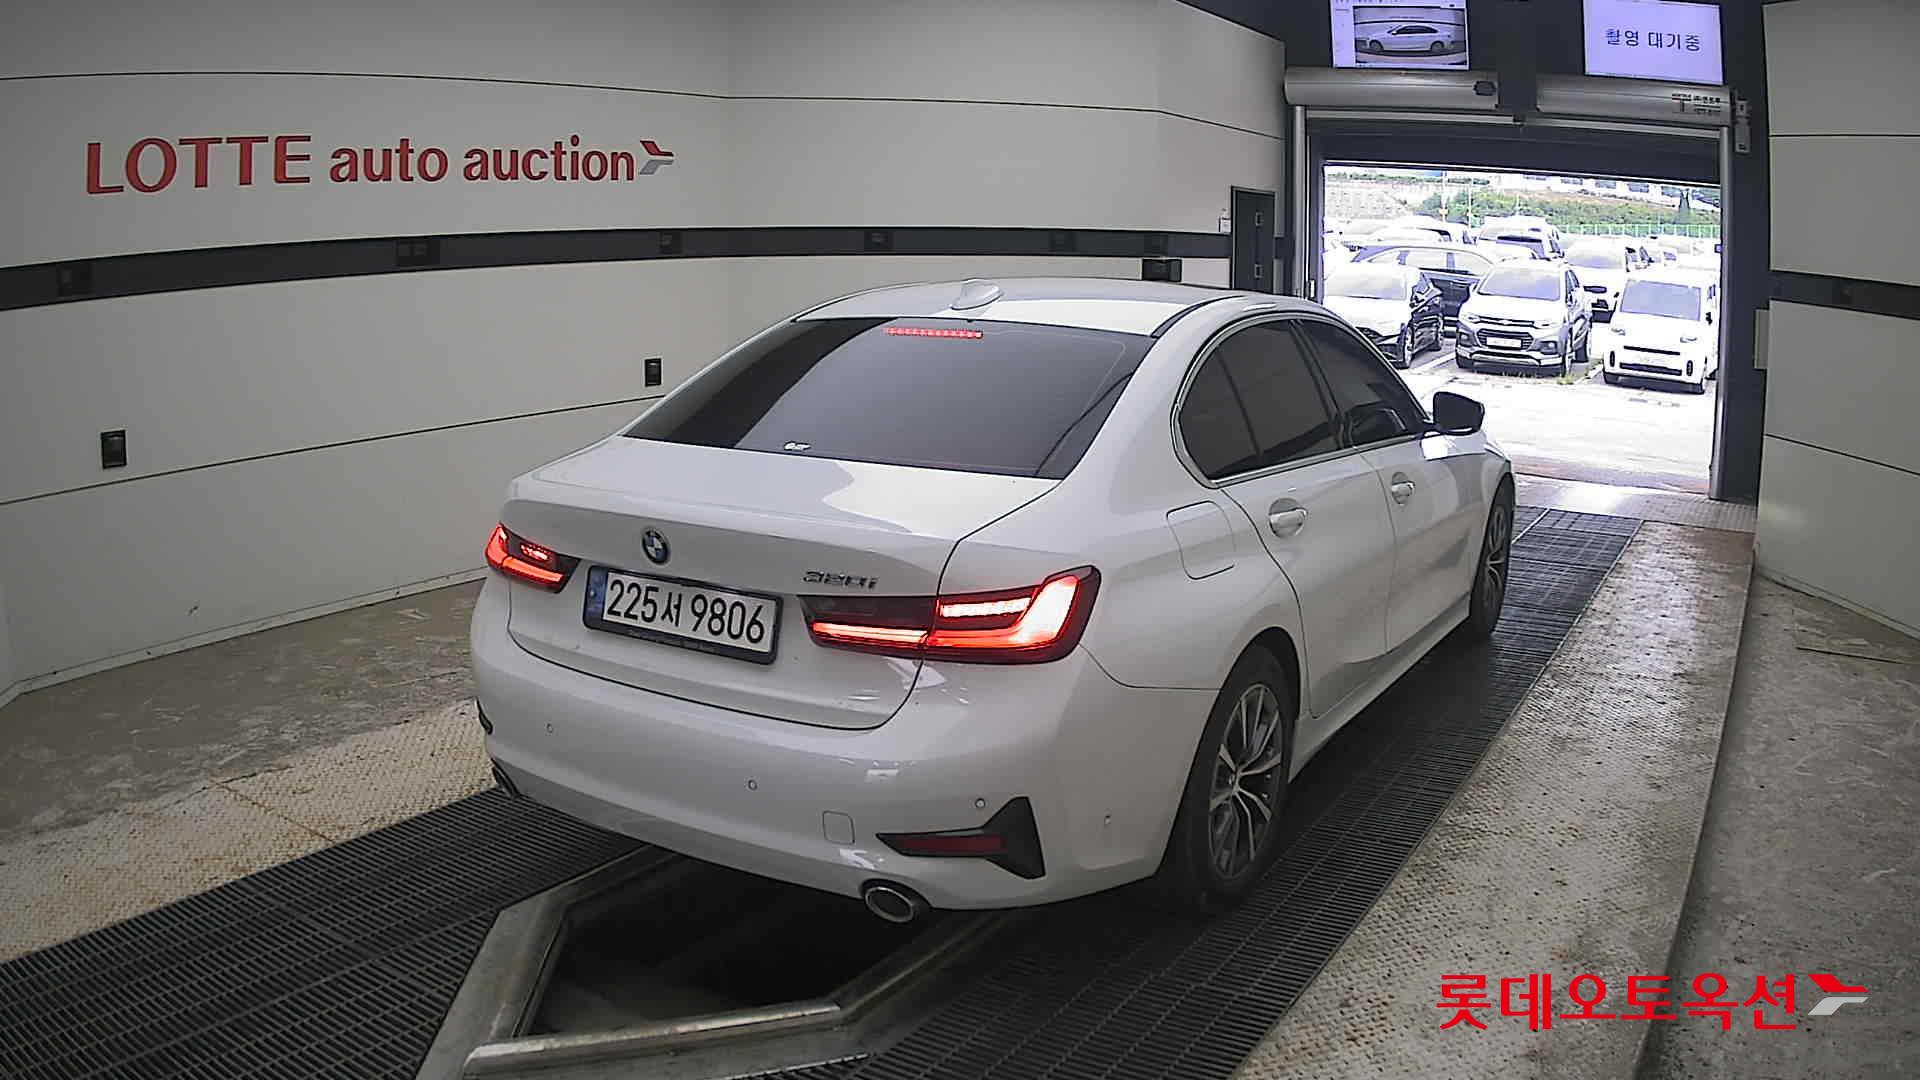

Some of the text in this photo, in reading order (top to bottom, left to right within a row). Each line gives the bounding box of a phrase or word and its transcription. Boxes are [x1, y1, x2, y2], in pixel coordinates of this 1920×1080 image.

[1605, 28, 1701, 52] 촬영 대기중
[86, 134, 635, 194] LOTTE auto auction
[606, 579, 682, 628] 225서
[690, 593, 765, 644] 9806
